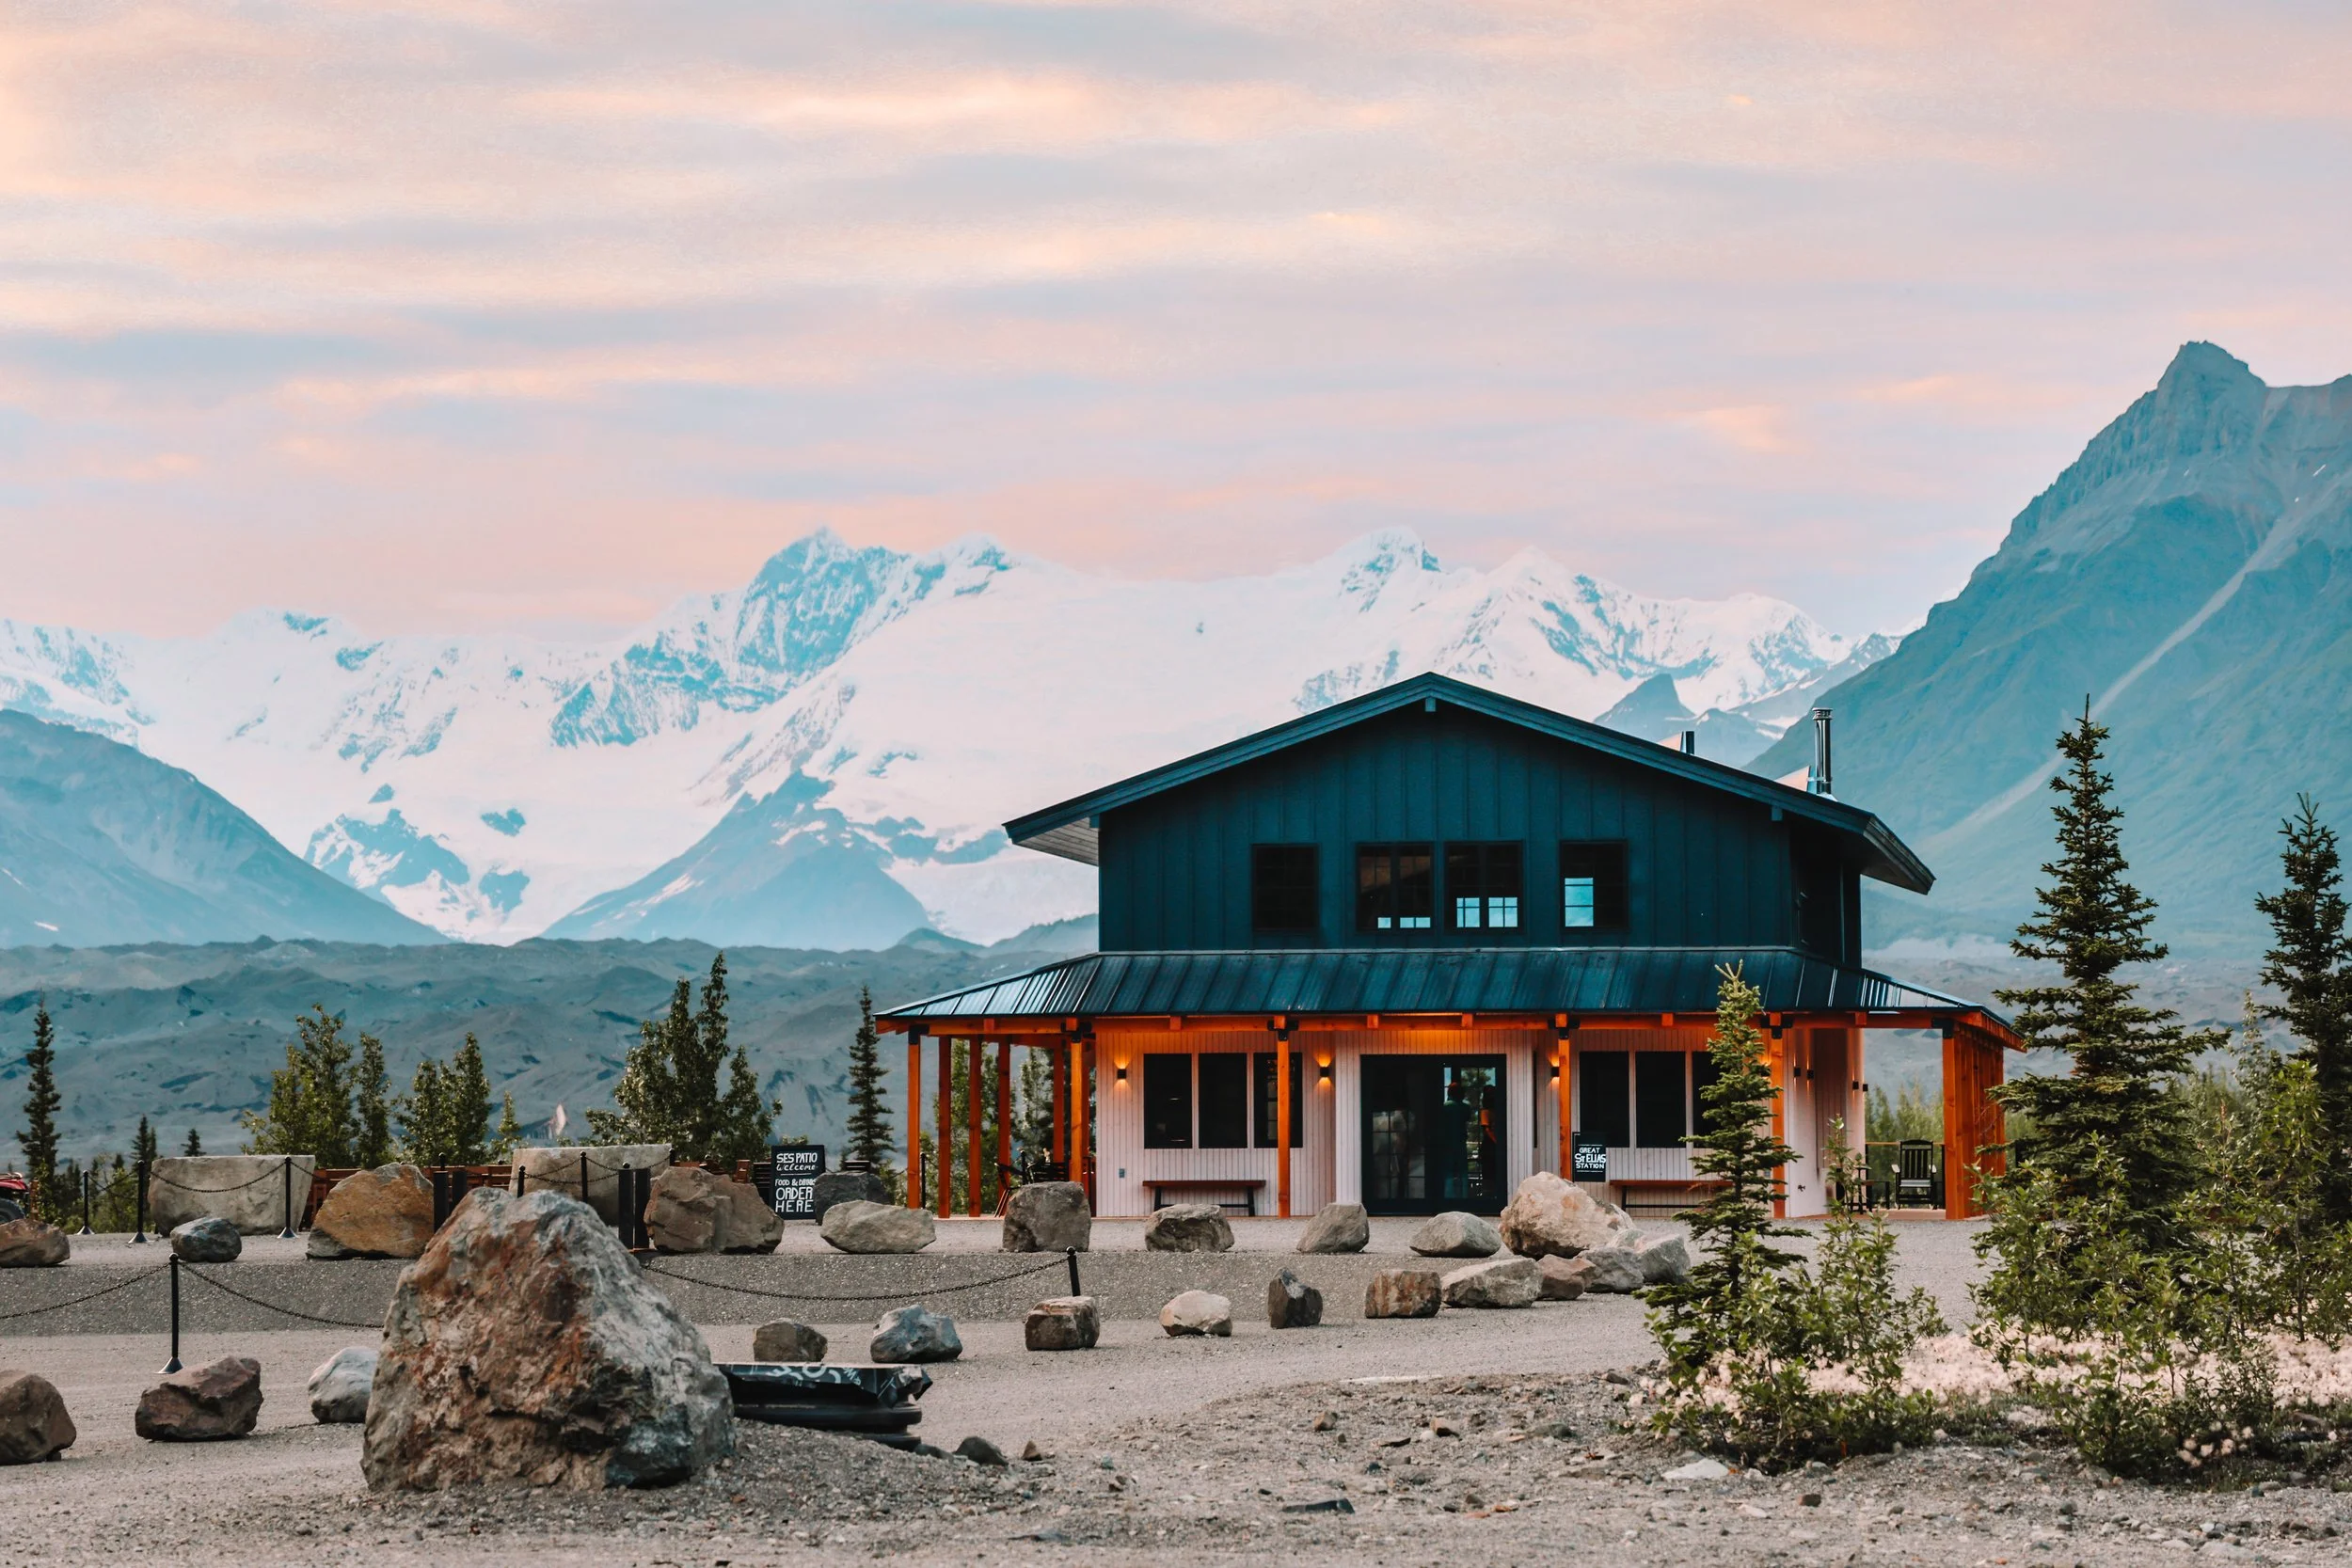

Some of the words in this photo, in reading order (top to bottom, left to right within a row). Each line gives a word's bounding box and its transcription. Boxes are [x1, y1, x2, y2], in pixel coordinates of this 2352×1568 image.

[776, 1152, 795, 1164] SES
[795, 1152, 818, 1163] PATIO
[1585, 1153, 1606, 1164] ELIAS
[775, 1186, 813, 1200] ORDER
[775, 1199, 814, 1212] HERE
